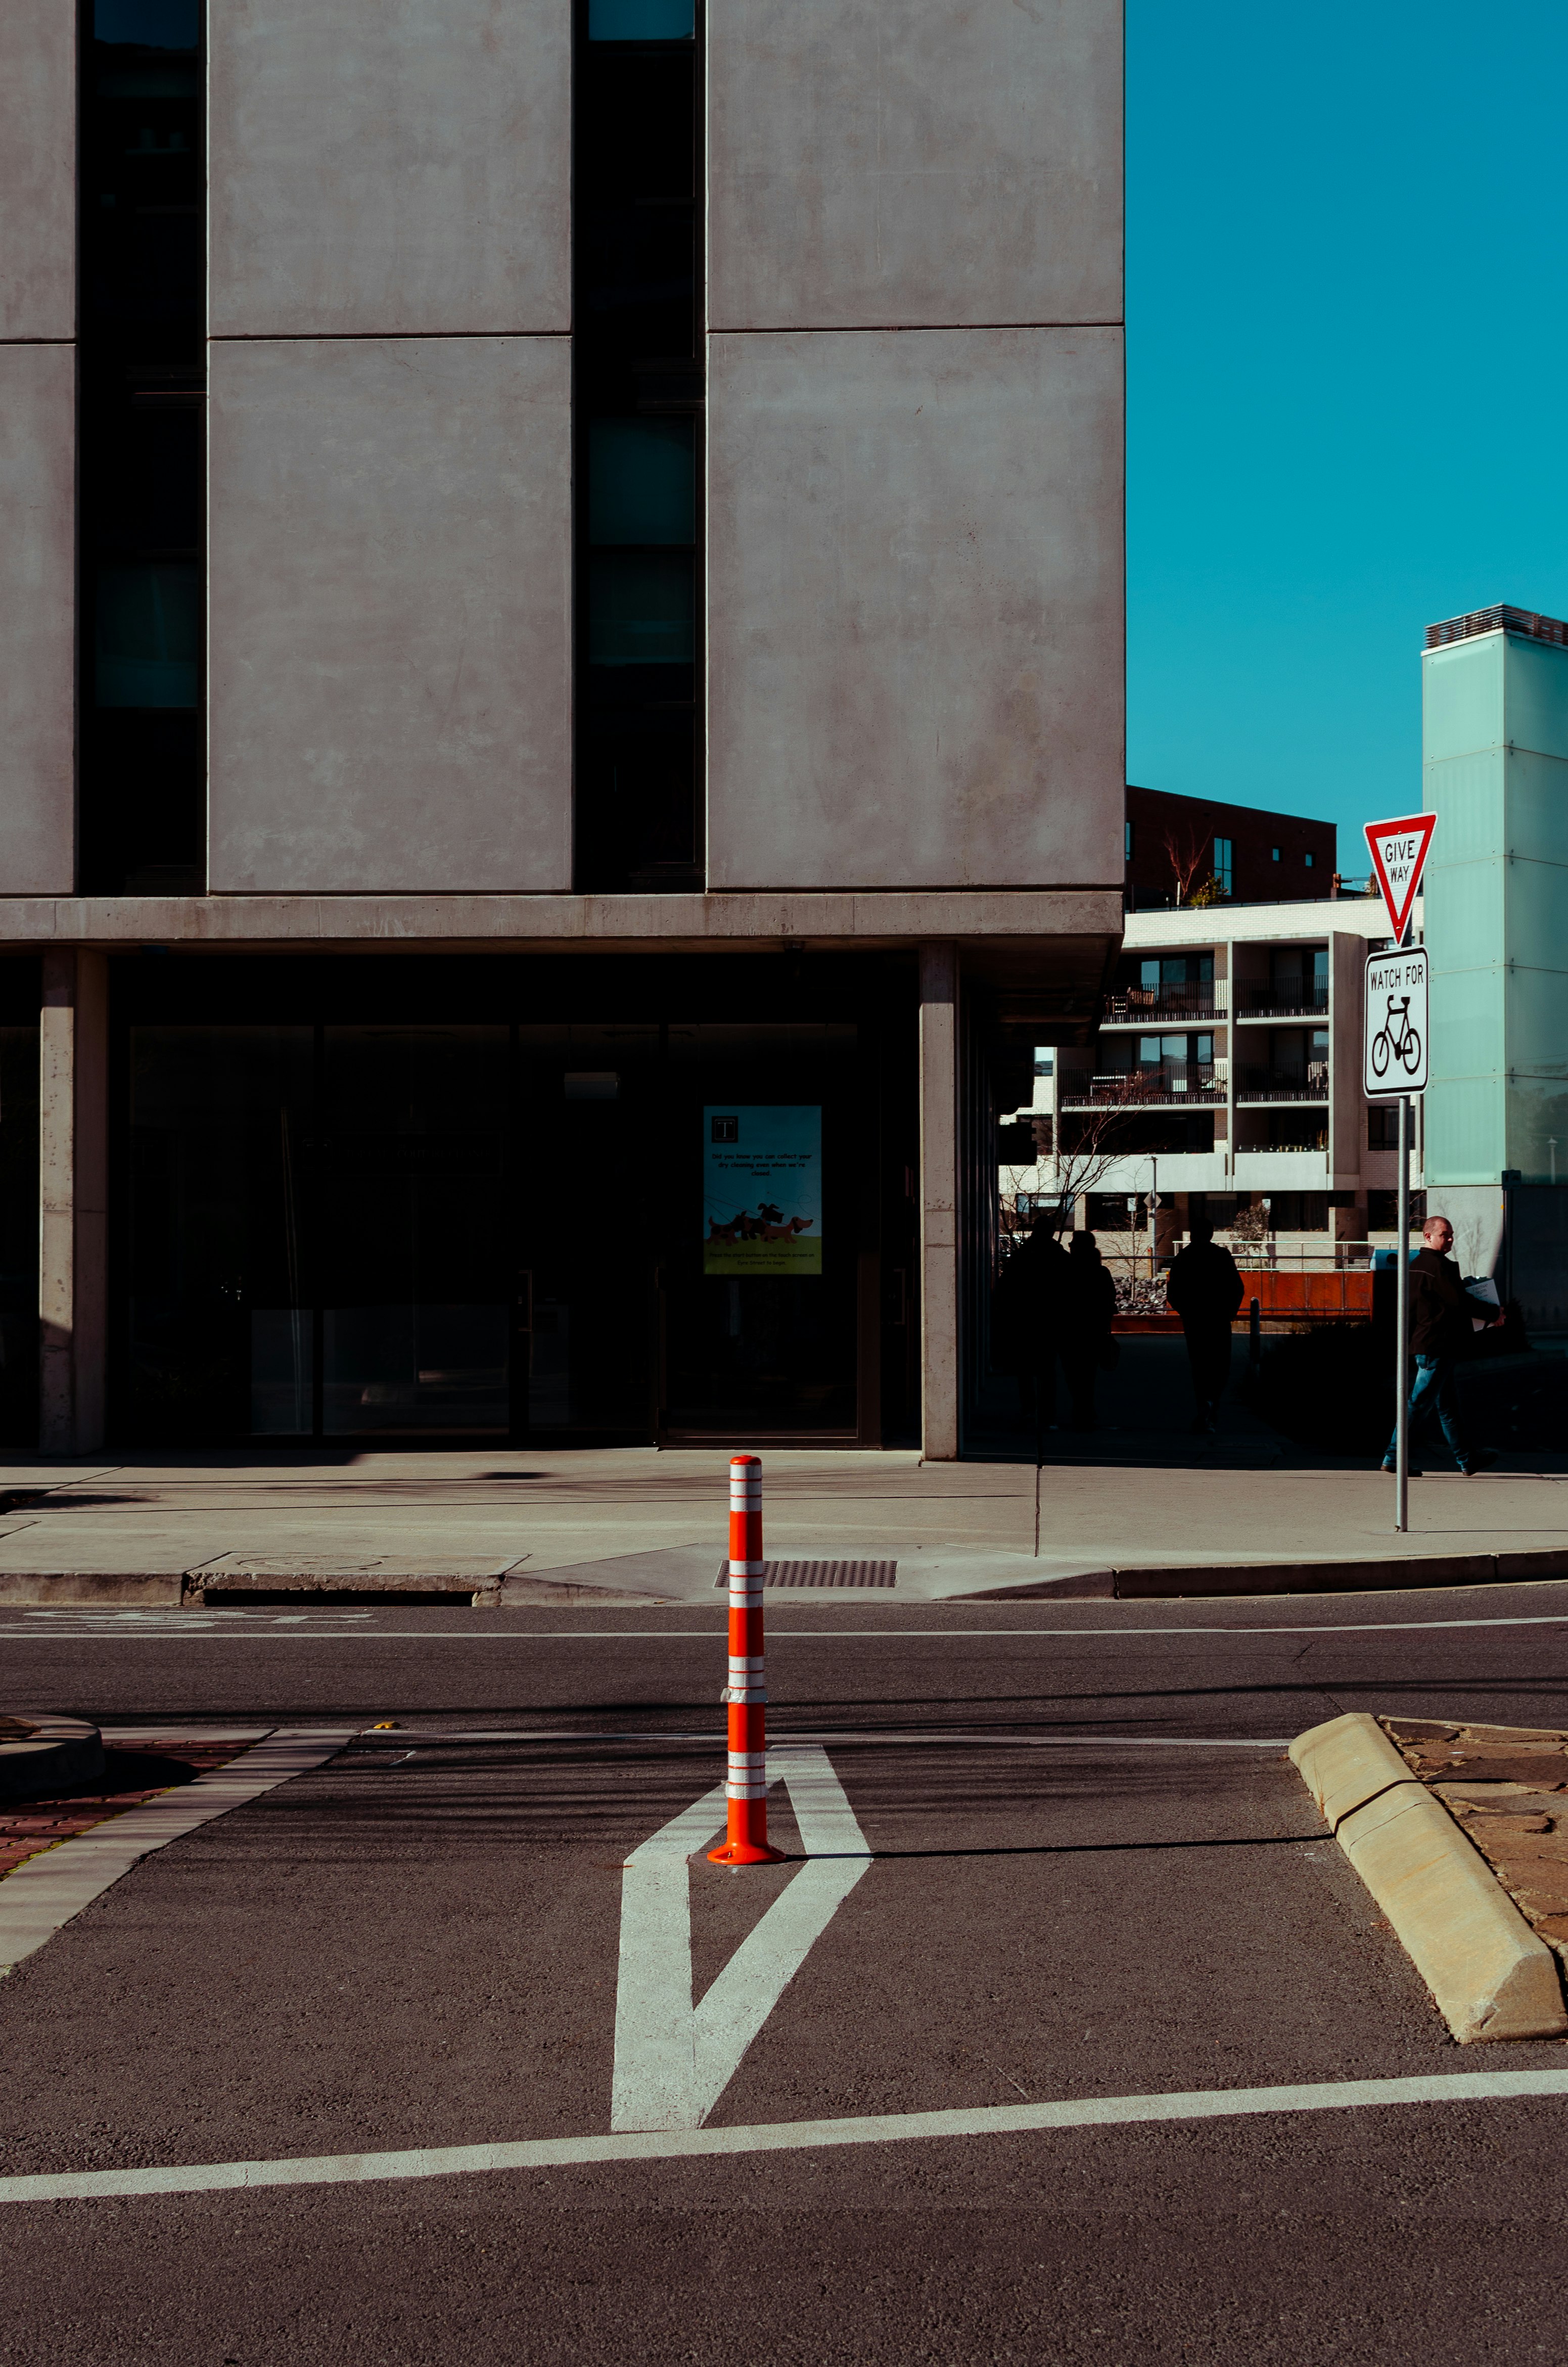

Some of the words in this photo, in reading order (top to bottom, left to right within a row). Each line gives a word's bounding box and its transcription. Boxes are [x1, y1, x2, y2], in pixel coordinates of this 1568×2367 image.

[1385, 840, 1416, 863] GIVE
[1390, 866, 1409, 883] WAY
[1370, 968, 1401, 991] WATCH
[1406, 964, 1424, 985] FOR
[718, 1122, 733, 1137] T
